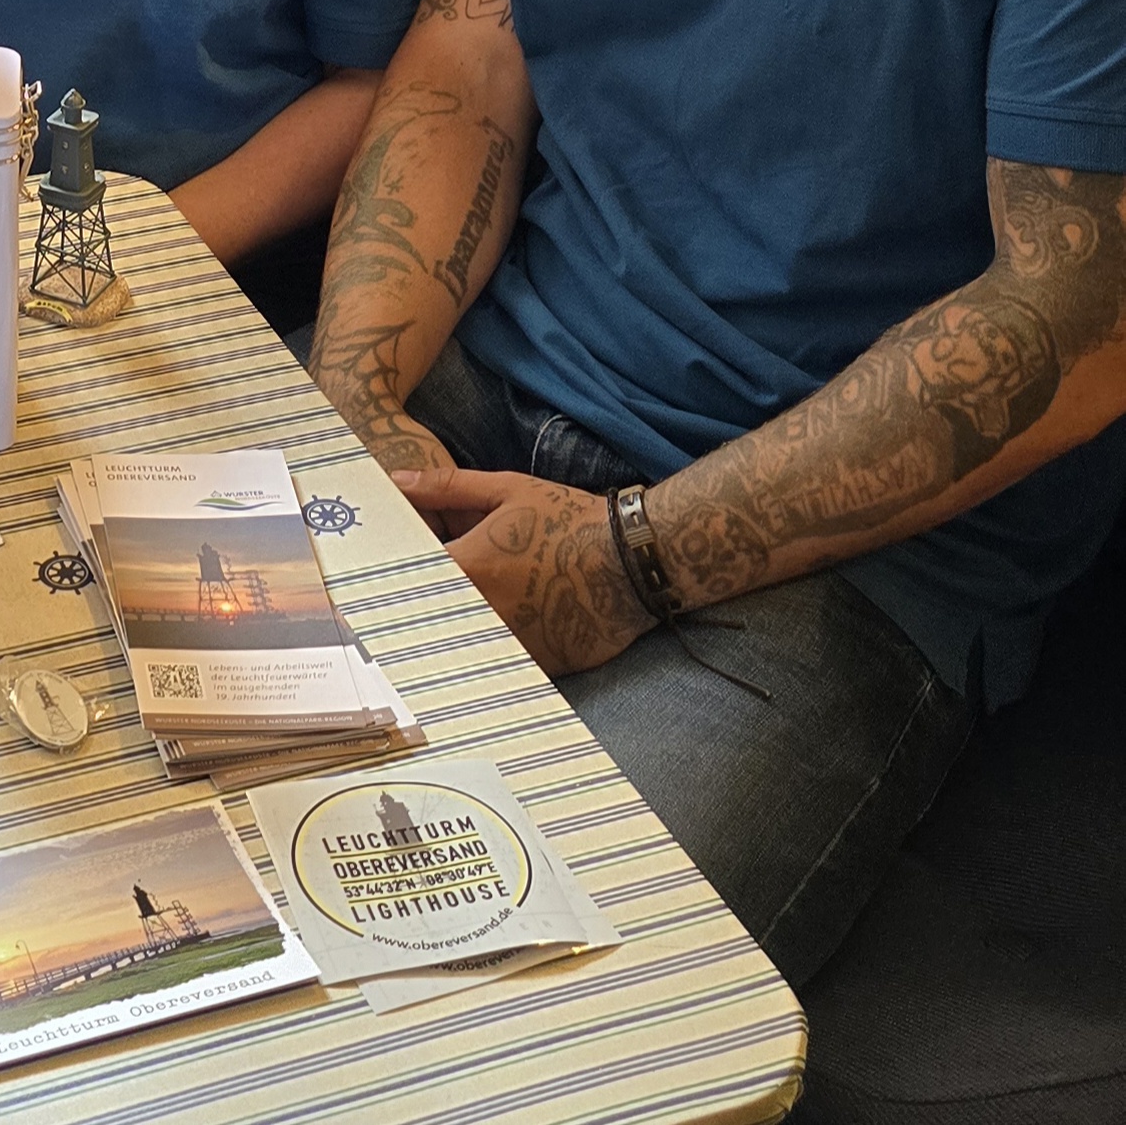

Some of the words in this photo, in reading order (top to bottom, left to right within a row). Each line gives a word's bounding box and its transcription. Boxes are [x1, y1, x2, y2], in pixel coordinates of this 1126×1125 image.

[105, 464, 182, 473] LEUCHTTURM
[107, 473, 197, 482] OBEREVERSAND
[224, 490, 264, 498] WURSTER
[209, 664, 248, 672] Lebens-
[251, 664, 271, 672] und
[274, 661, 333, 672] Arbeitswelt
[211, 673, 228, 681] der
[230, 683, 300, 693] ausgehenden
[322, 815, 477, 855] LEUCHTTURM
[332, 838, 489, 880] OBEREVERSAND
[350, 880, 510, 924] LIGHTHOUSE
[372, 907, 513, 951] www.obereversand.de
[129, 970, 276, 1018] Obereversand
